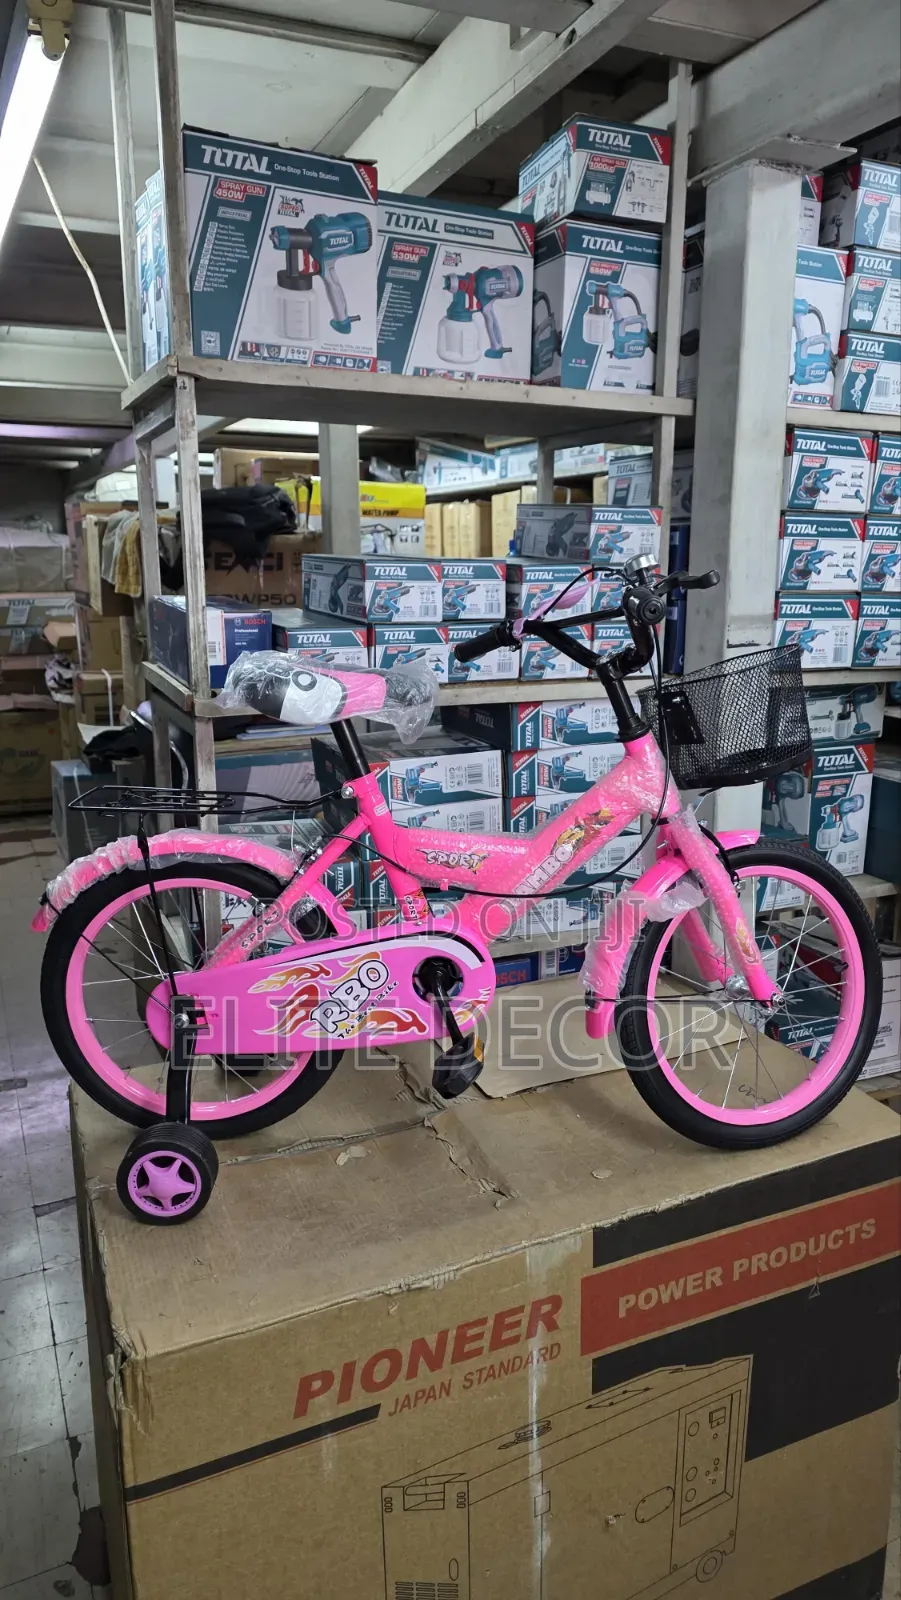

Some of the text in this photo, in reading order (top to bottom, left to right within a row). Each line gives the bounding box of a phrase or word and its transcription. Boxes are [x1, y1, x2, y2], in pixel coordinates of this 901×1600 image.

[588, 128, 632, 148] TOTAL
[201, 145, 272, 175] TOTAL
[274, 163, 340, 181] One-Stop Tools Station
[359, 167, 374, 190] TOTAL
[864, 168, 898, 187] TOTAL
[216, 188, 244, 200] 450W
[220, 180, 263, 194] SPRAY GUN
[384, 211, 440, 234] TOTAL
[330, 236, 349, 246] TOTAL
[520, 226, 533, 246] TOTAL
[582, 235, 624, 254] TOTAL
[392, 251, 420, 262] 530W
[858, 255, 892, 272] TOTAL
[851, 338, 885, 354] TOTAL
[796, 438, 826, 451] TOTAL
[594, 512, 623, 521] TOTAL
[786, 524, 818, 534] TOTAL
[868, 526, 898, 536] TOTAL
[374, 566, 408, 576] TOTAL
[443, 565, 475, 575] TOTAL
[526, 571, 554, 580] TOTAL
[781, 604, 812, 614] TOTAL
[863, 605, 890, 615] TOTAL
[297, 634, 332, 644] TOTAL
[384, 632, 416, 640] TOTAL
[448, 630, 477, 639] TOTAL
[598, 628, 625, 637] TOTAL
[520, 706, 534, 720] TOTAL
[515, 754, 529, 768] TOTAL
[817, 754, 856, 768] TOTAL
[858, 746, 869, 763] TOTAL
[512, 801, 527, 815] TOTAL
[422, 849, 484, 872] SPORT
[404, 895, 418, 920] SPORT
[378, 914, 392, 926] TOTAL
[337, 981, 398, 1038] The Best Bike
[618, 1218, 877, 1319] POWER PRODUCTS
[293, 1294, 563, 1420] PIONEER
[388, 1342, 562, 1417] JAPAN STANDARD
